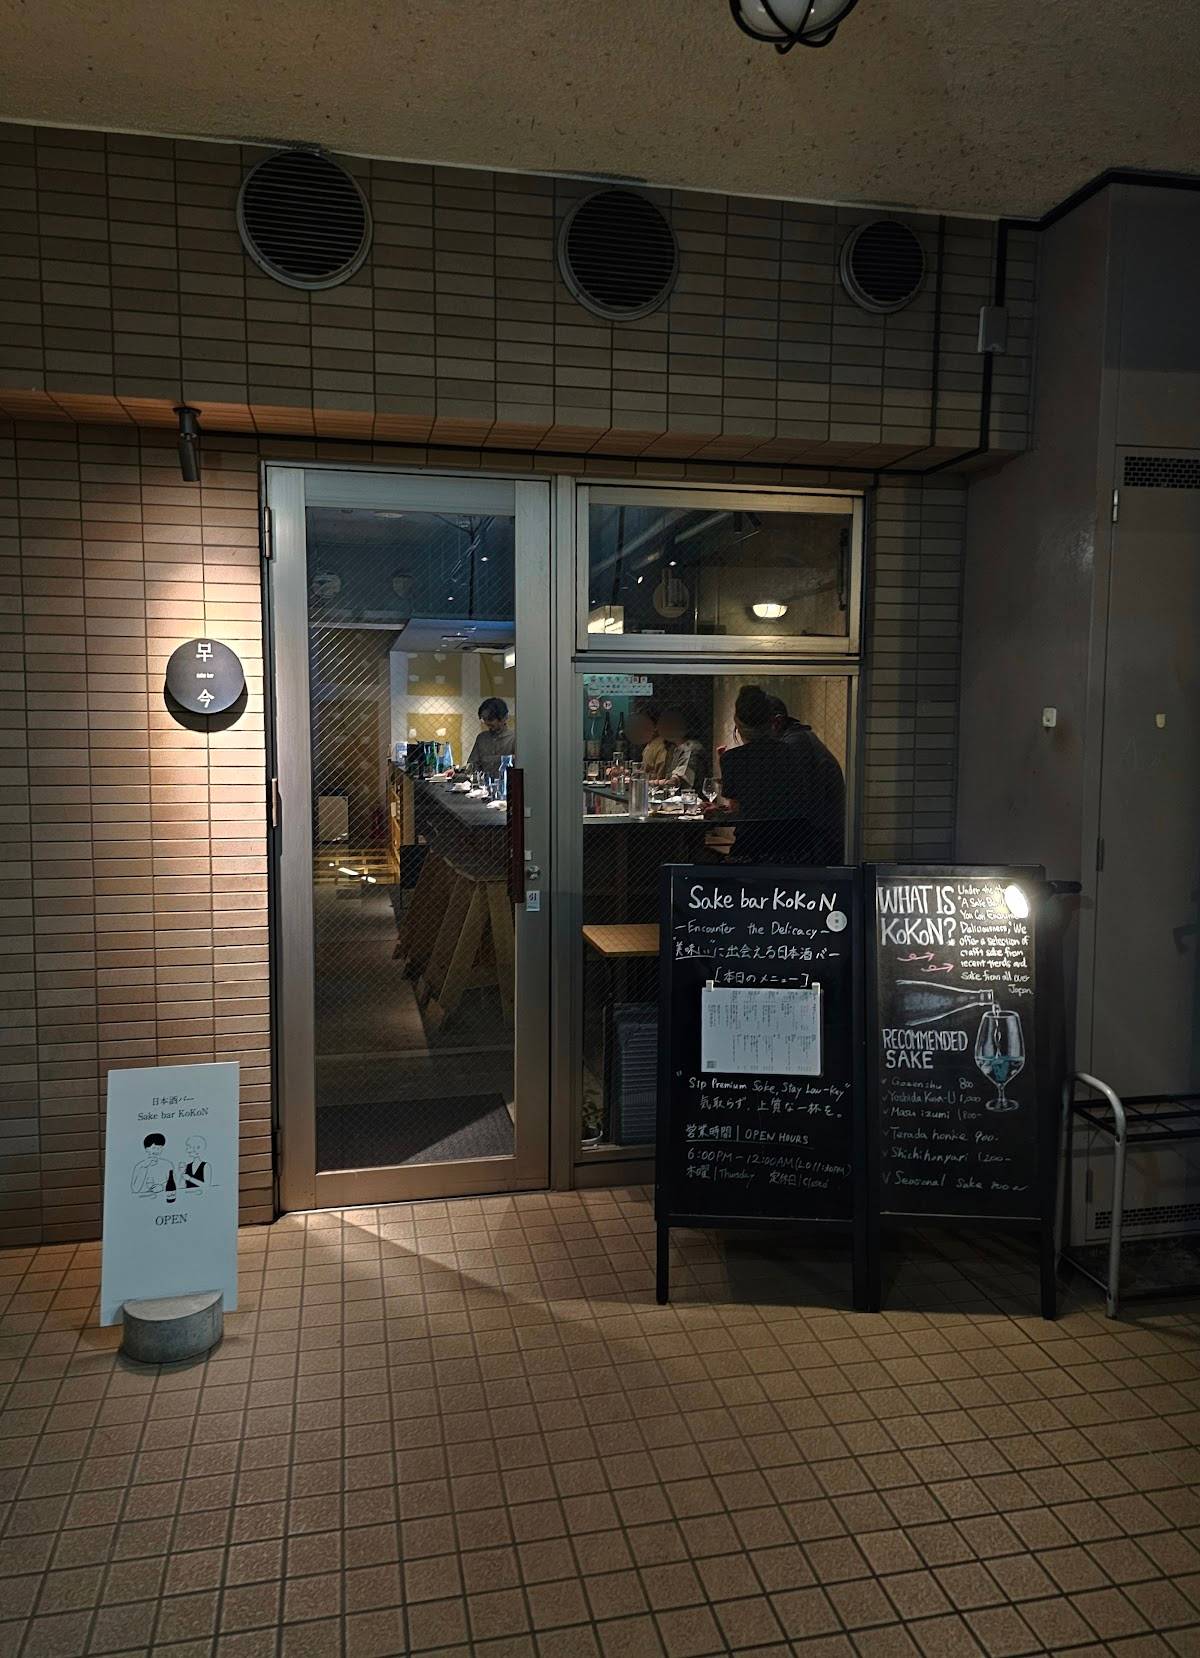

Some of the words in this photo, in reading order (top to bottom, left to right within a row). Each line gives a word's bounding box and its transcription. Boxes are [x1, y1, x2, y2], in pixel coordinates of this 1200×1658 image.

[688, 885, 734, 910] Sake
[740, 888, 769, 910] bar
[877, 885, 933, 914] WHAT
[936, 885, 956, 915] IS
[747, 921, 765, 935] the
[1013, 922, 1028, 934] We
[980, 937, 986, 946] a
[1021, 935, 1031, 946] of
[1005, 947, 1024, 957] from
[960, 959, 987, 968] recent
[983, 969, 1001, 982] from
[1001, 971, 1013, 981] all
[882, 1028, 969, 1051] RECOMMENDED
[885, 1050, 934, 1069] SAKE
[712, 1077, 747, 1090] Premium
[781, 1081, 801, 1100] Stay
[152, 1095, 195, 1106] 日本酒バー
[137, 1110, 158, 1121] Sake
[161, 1110, 176, 1120] bar
[686, 1123, 732, 1139] 営業時間
[745, 1129, 775, 1142] OPEN
[778, 1133, 809, 1144] HOURS
[155, 1213, 189, 1226] OPEN
